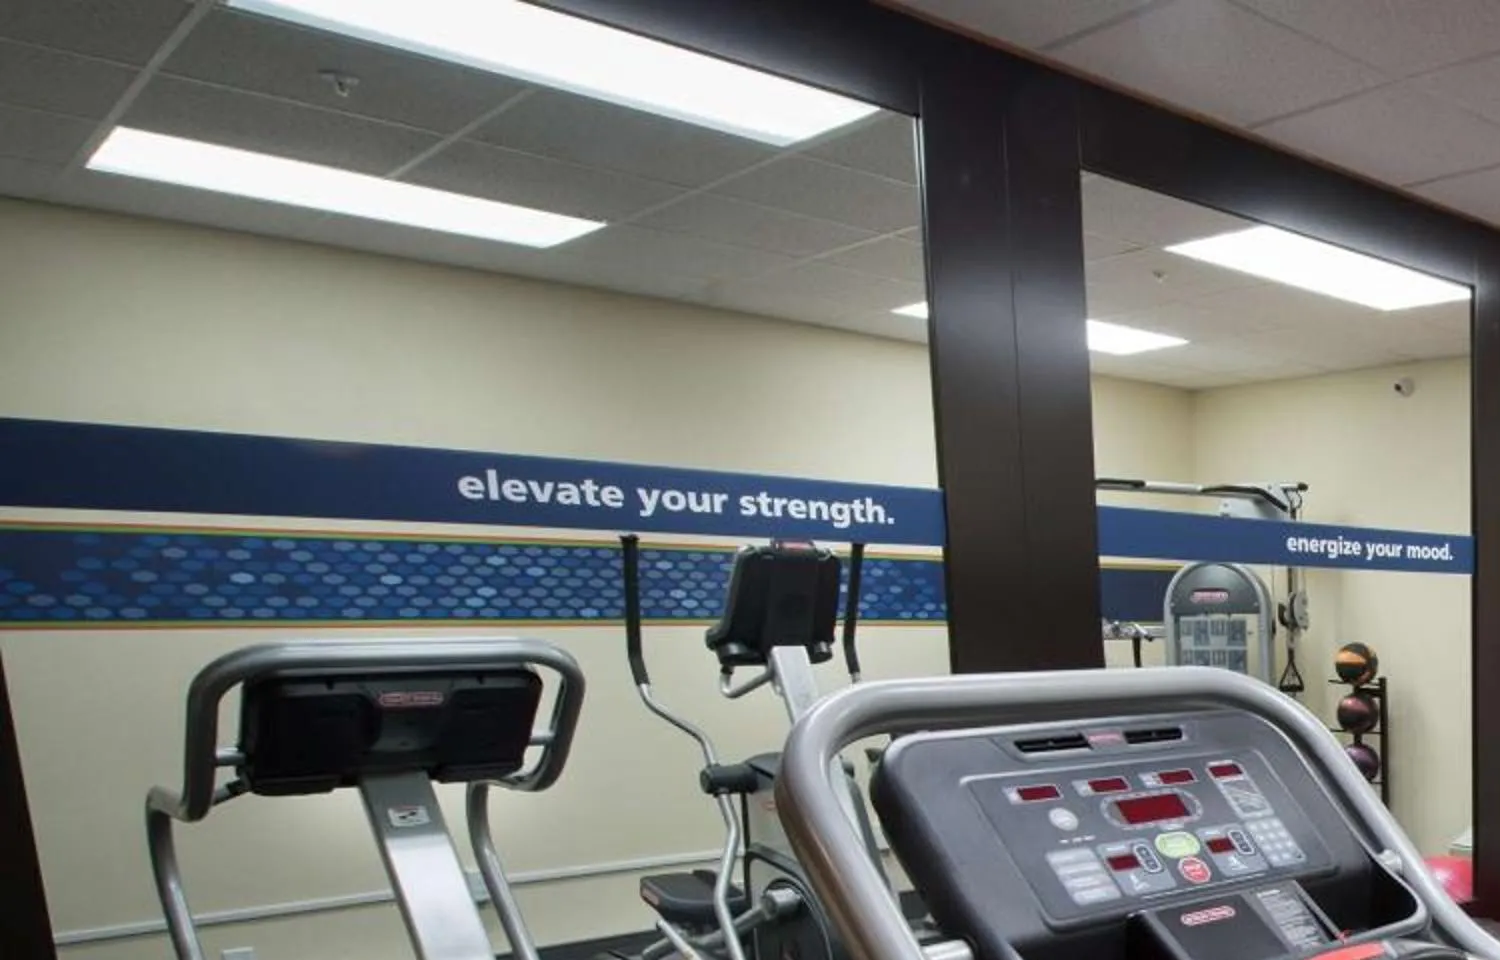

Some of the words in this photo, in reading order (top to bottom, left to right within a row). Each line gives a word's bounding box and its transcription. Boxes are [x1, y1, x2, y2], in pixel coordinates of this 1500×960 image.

[458, 469, 625, 508] elevate
[637, 487, 729, 517] your
[740, 491, 895, 529] strength.
[1286, 535, 1362, 559] energize
[1366, 542, 1403, 561] your
[1407, 543, 1454, 561] mood.
